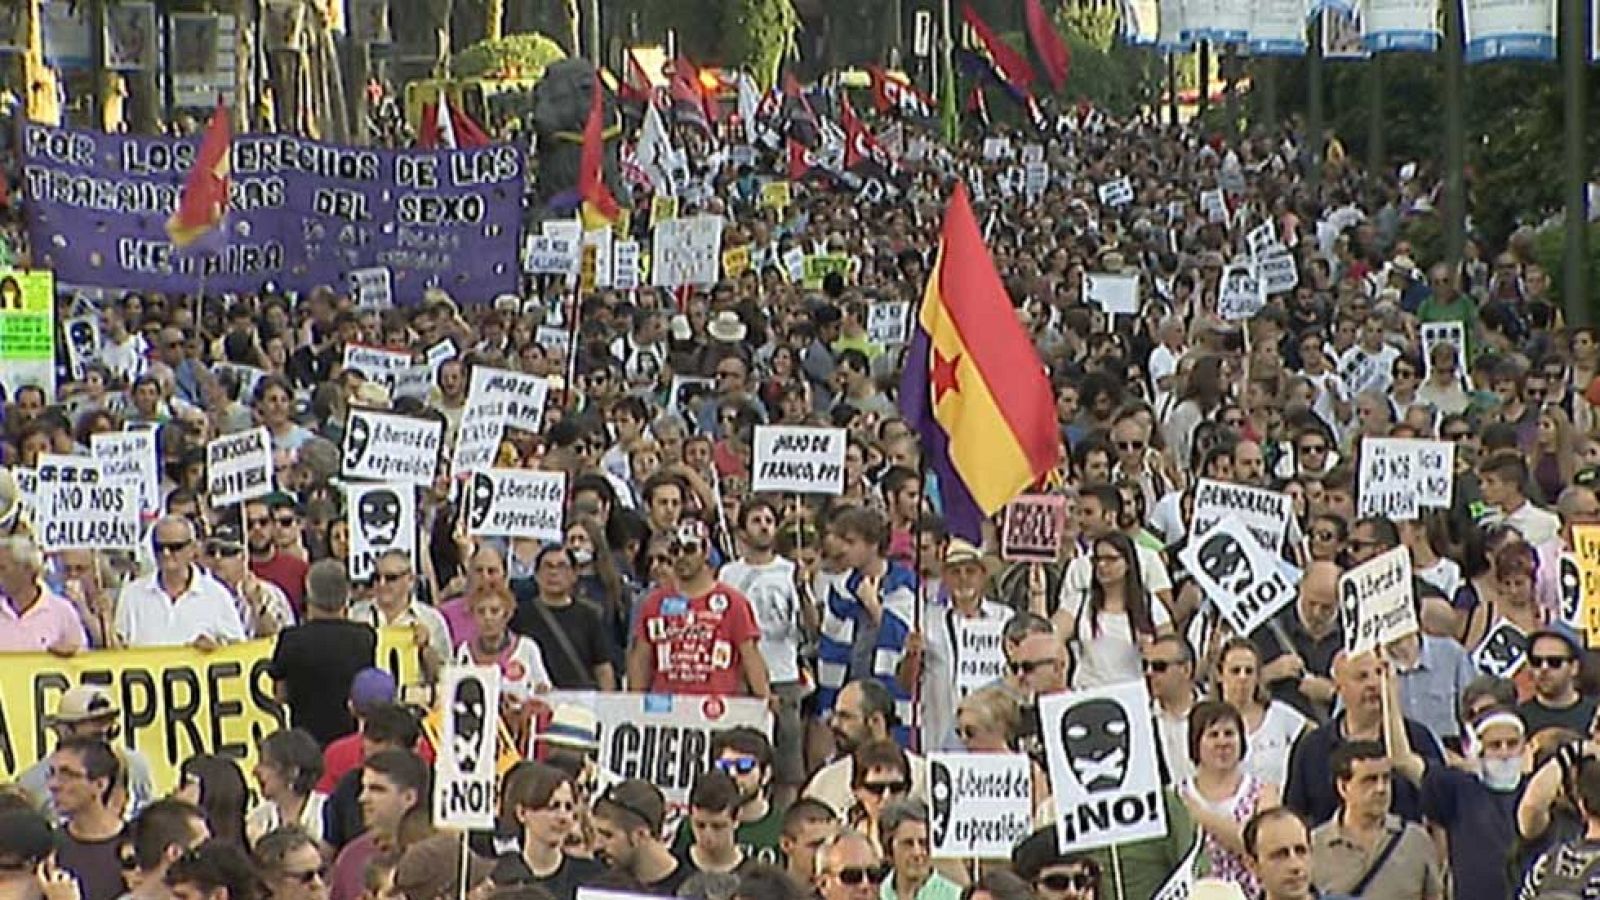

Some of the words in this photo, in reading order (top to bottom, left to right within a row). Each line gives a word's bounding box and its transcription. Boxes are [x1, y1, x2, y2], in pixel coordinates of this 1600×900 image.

[26, 127, 95, 166] POR
[123, 140, 196, 176] LOS
[232, 138, 380, 182] ERECHOS
[395, 155, 438, 190] DE
[451, 146, 519, 187] LAS
[26, 165, 283, 214] TRABAJARAS
[313, 188, 372, 222] DEL
[397, 193, 486, 226] SEXO
[52, 486, 83, 518] ¡NO
[89, 486, 125, 512] NOS
[1231, 571, 1288, 630] ¡NO!
[35, 657, 292, 767] RPRES
[610, 721, 712, 788] CIER
[1064, 790, 1158, 842] ¡NO!
